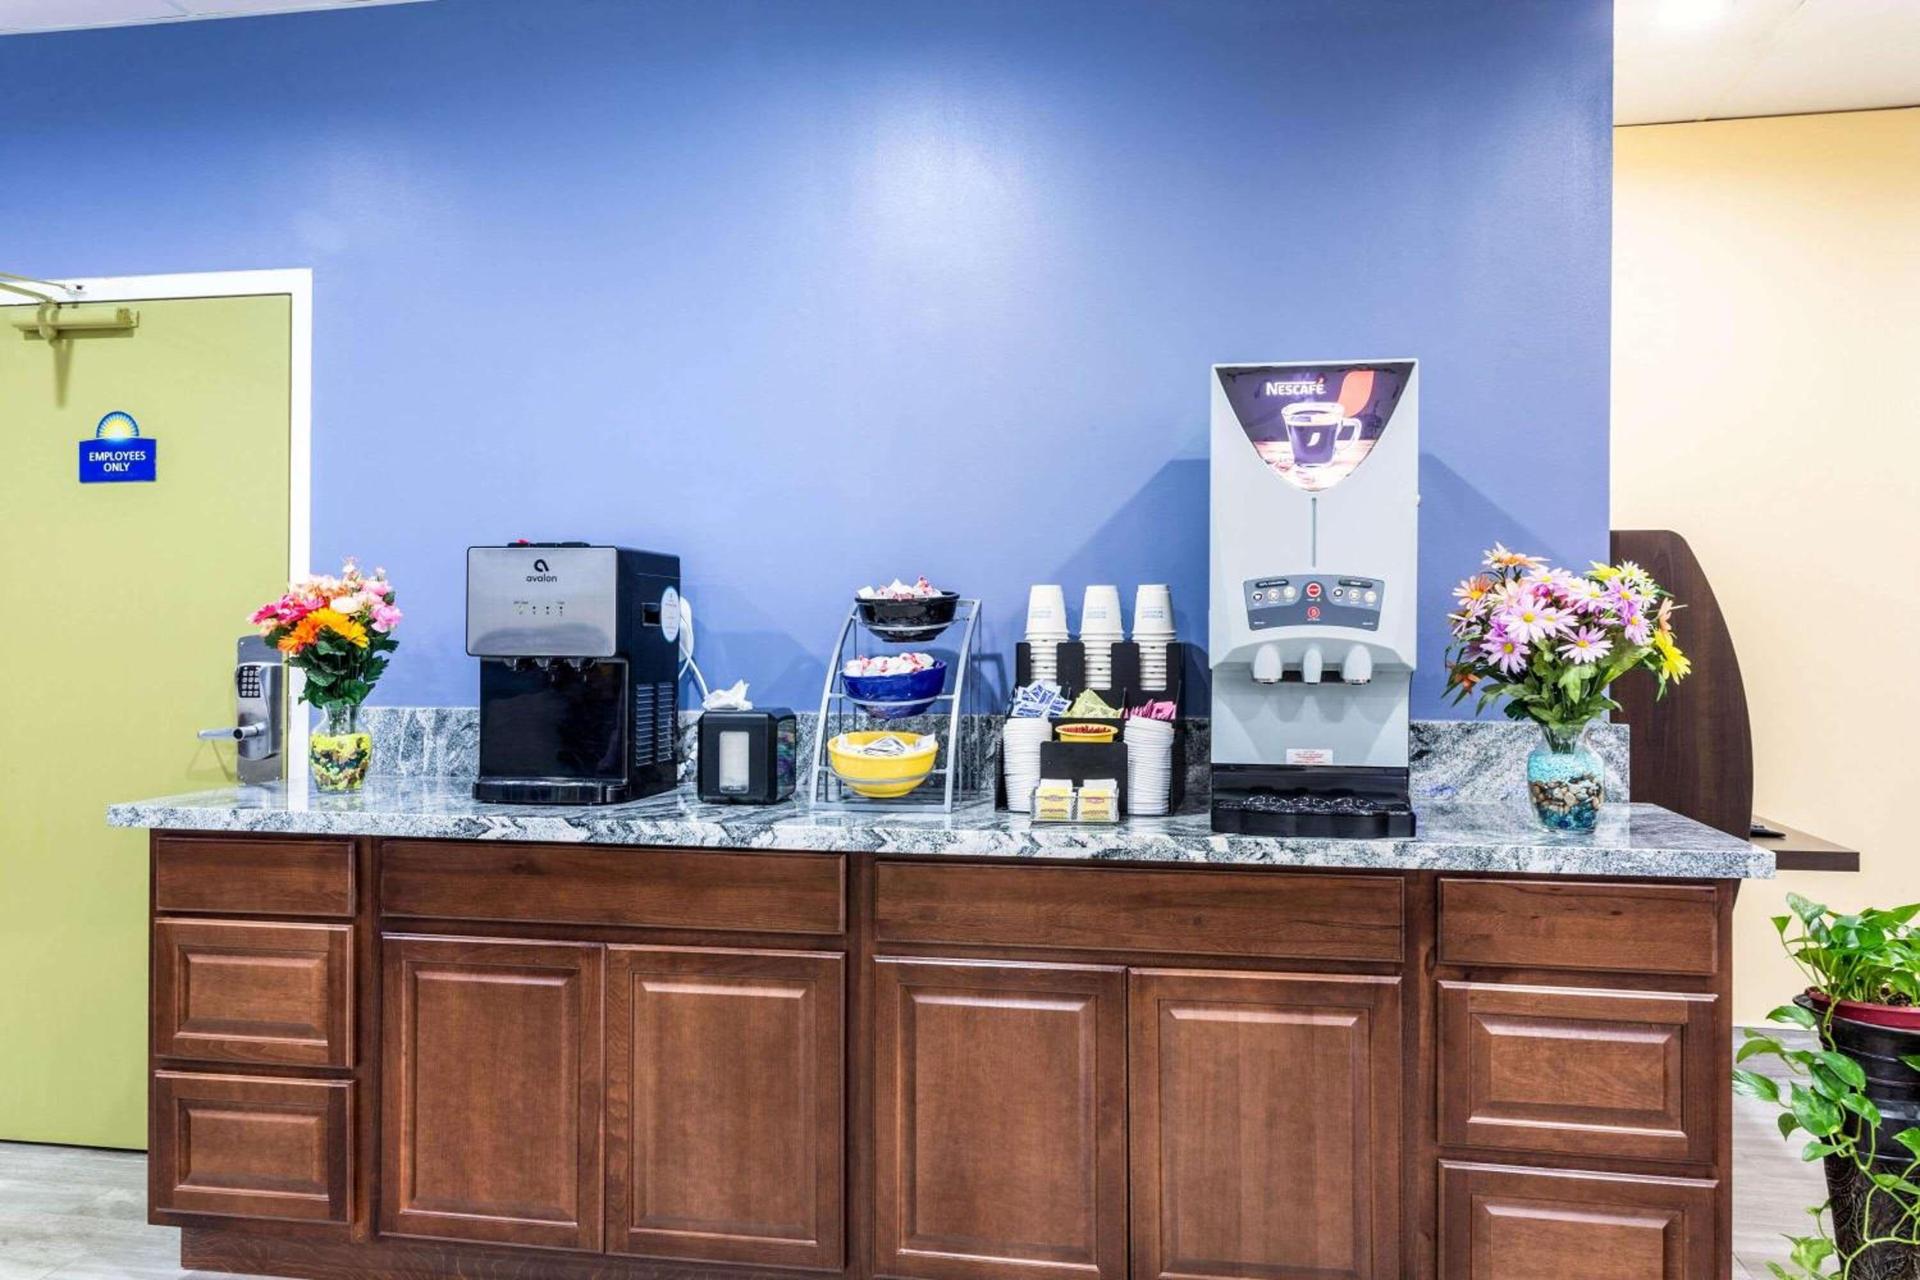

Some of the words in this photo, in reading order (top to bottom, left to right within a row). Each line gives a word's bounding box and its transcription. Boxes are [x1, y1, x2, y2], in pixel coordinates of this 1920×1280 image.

[1266, 378, 1326, 396] NESCAFÉ
[88, 451, 146, 462] EMPLOYEES
[103, 462, 130, 472] ONLY
[526, 573, 558, 583] avalon
